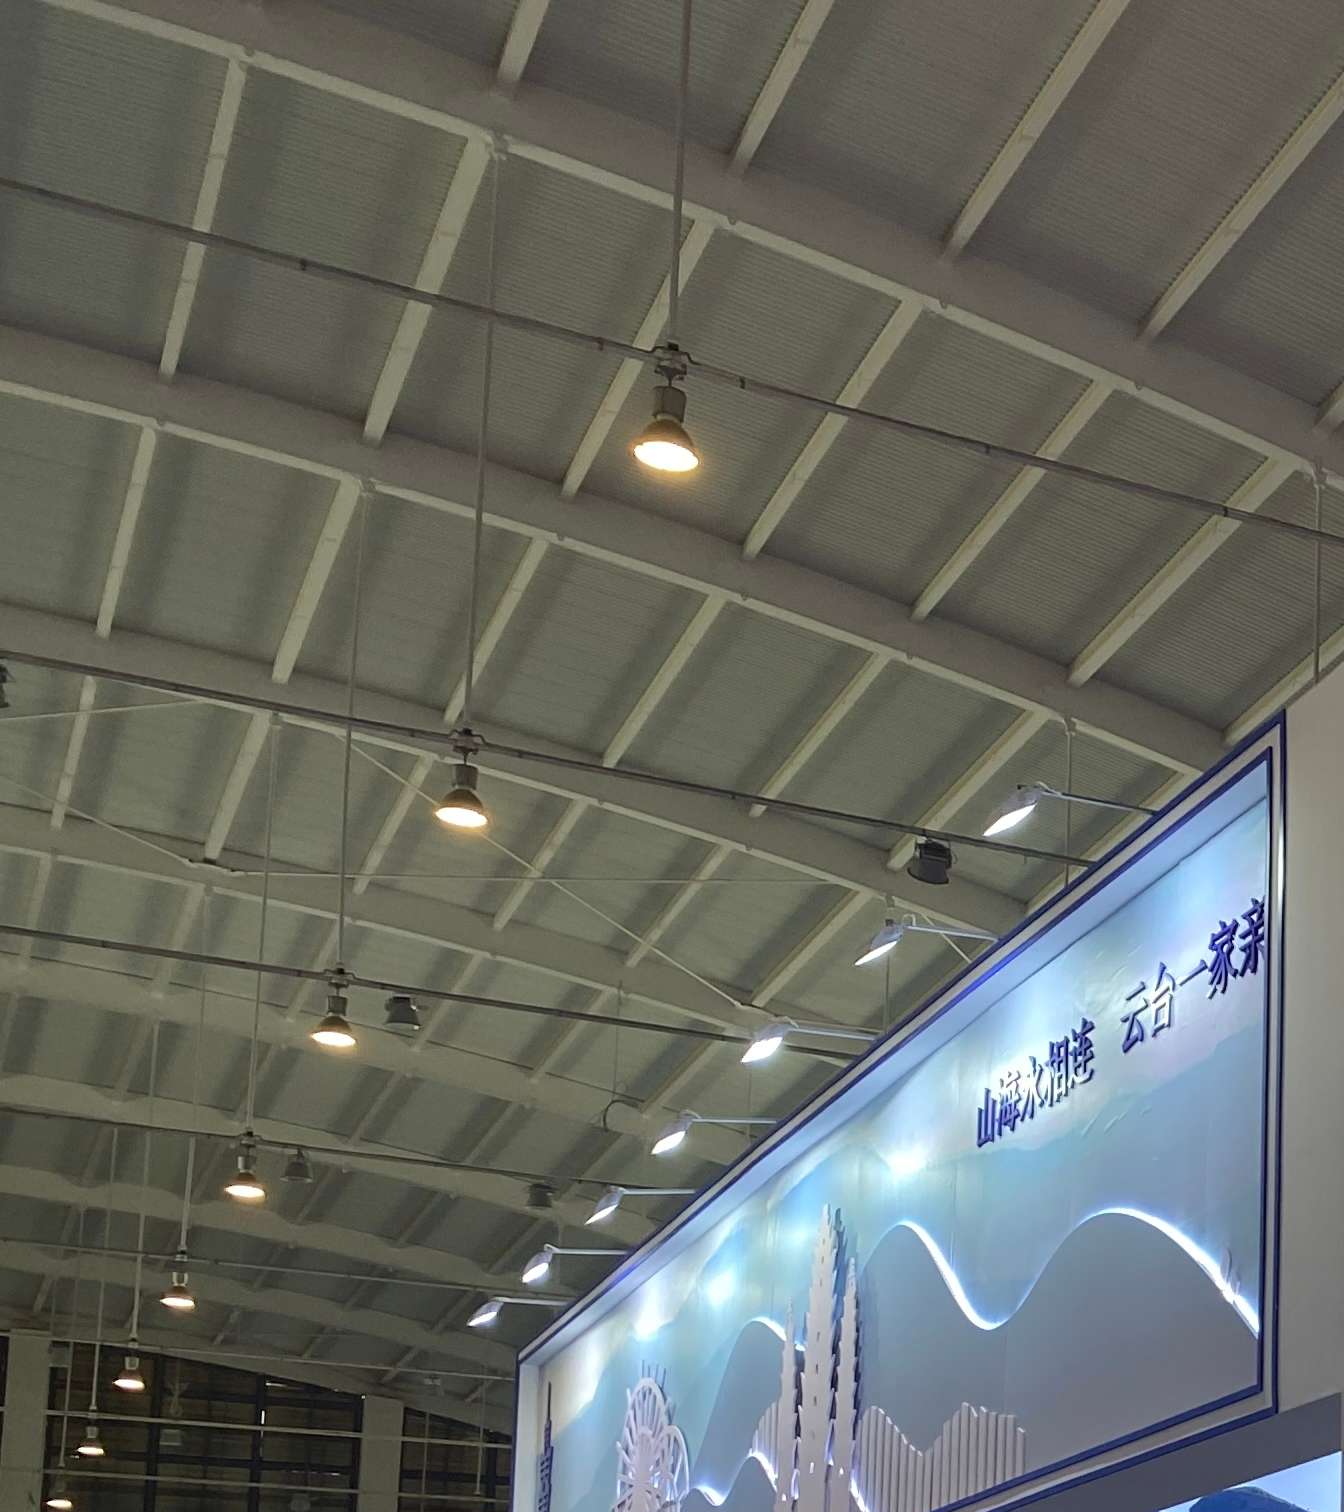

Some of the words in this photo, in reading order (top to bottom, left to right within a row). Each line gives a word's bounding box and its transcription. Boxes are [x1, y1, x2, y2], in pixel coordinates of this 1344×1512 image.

[1120, 896, 1265, 1053] 云台一家亲
